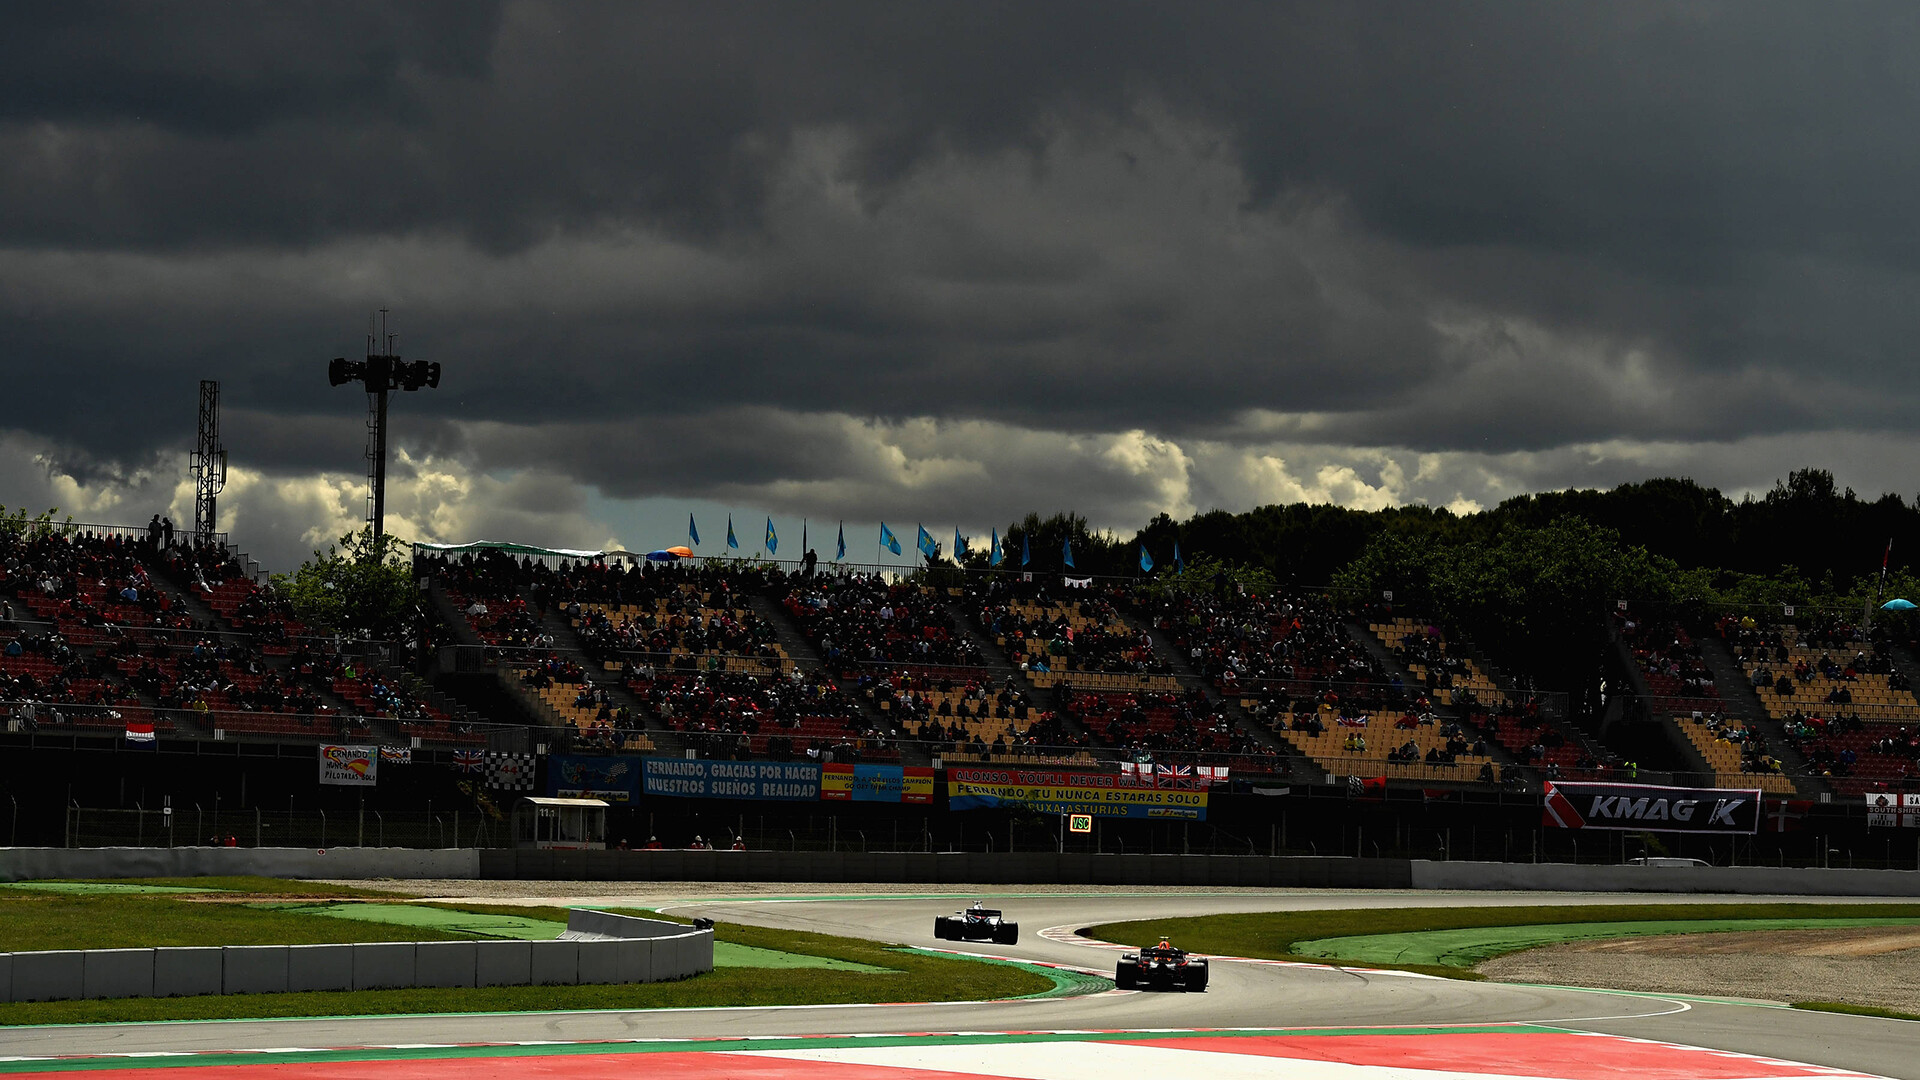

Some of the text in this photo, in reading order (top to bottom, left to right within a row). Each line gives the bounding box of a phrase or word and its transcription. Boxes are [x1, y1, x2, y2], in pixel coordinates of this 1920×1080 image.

[501, 765, 518, 775] 44
[646, 760, 818, 781] FERNANDO, GRACIAS POR HACER
[647, 777, 817, 797] NUESTROS SUEÑOS REALIDAD
[956, 770, 1013, 785] ALONSO,
[1017, 772, 1065, 785] YOU'LL
[1069, 774, 1114, 788] NEVER
[1034, 788, 1051, 799] TU
[1056, 789, 1100, 801] NUNCA
[1106, 791, 1162, 803] ESTARAS
[1167, 793, 1201, 805] SOLO
[1066, 803, 1128, 816] ASTURIAS
[1588, 796, 1699, 822] KMAG
[1072, 817, 1089, 830] VSC
